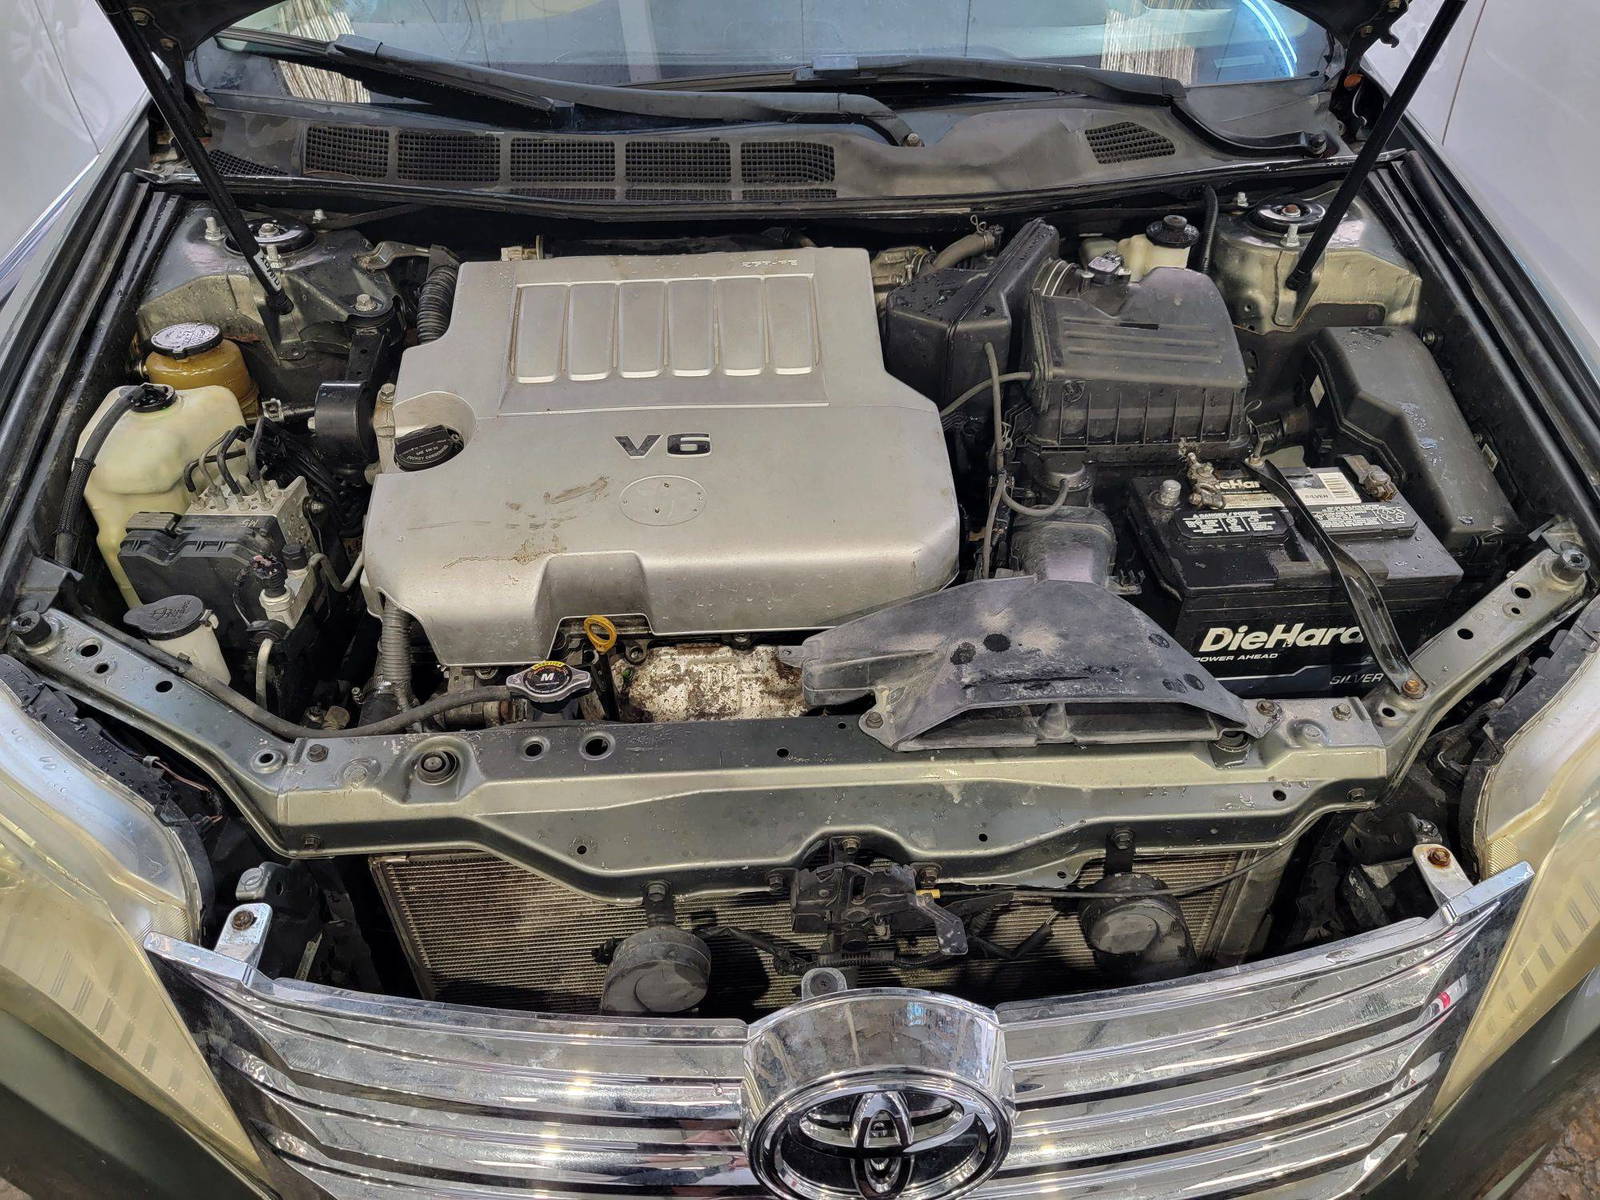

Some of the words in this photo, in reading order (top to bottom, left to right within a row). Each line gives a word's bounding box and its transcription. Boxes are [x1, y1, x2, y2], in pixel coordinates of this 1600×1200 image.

[614, 433, 712, 459] V6
[1237, 653, 1279, 661] AHEAD
[1329, 673, 1384, 685] SILVER
